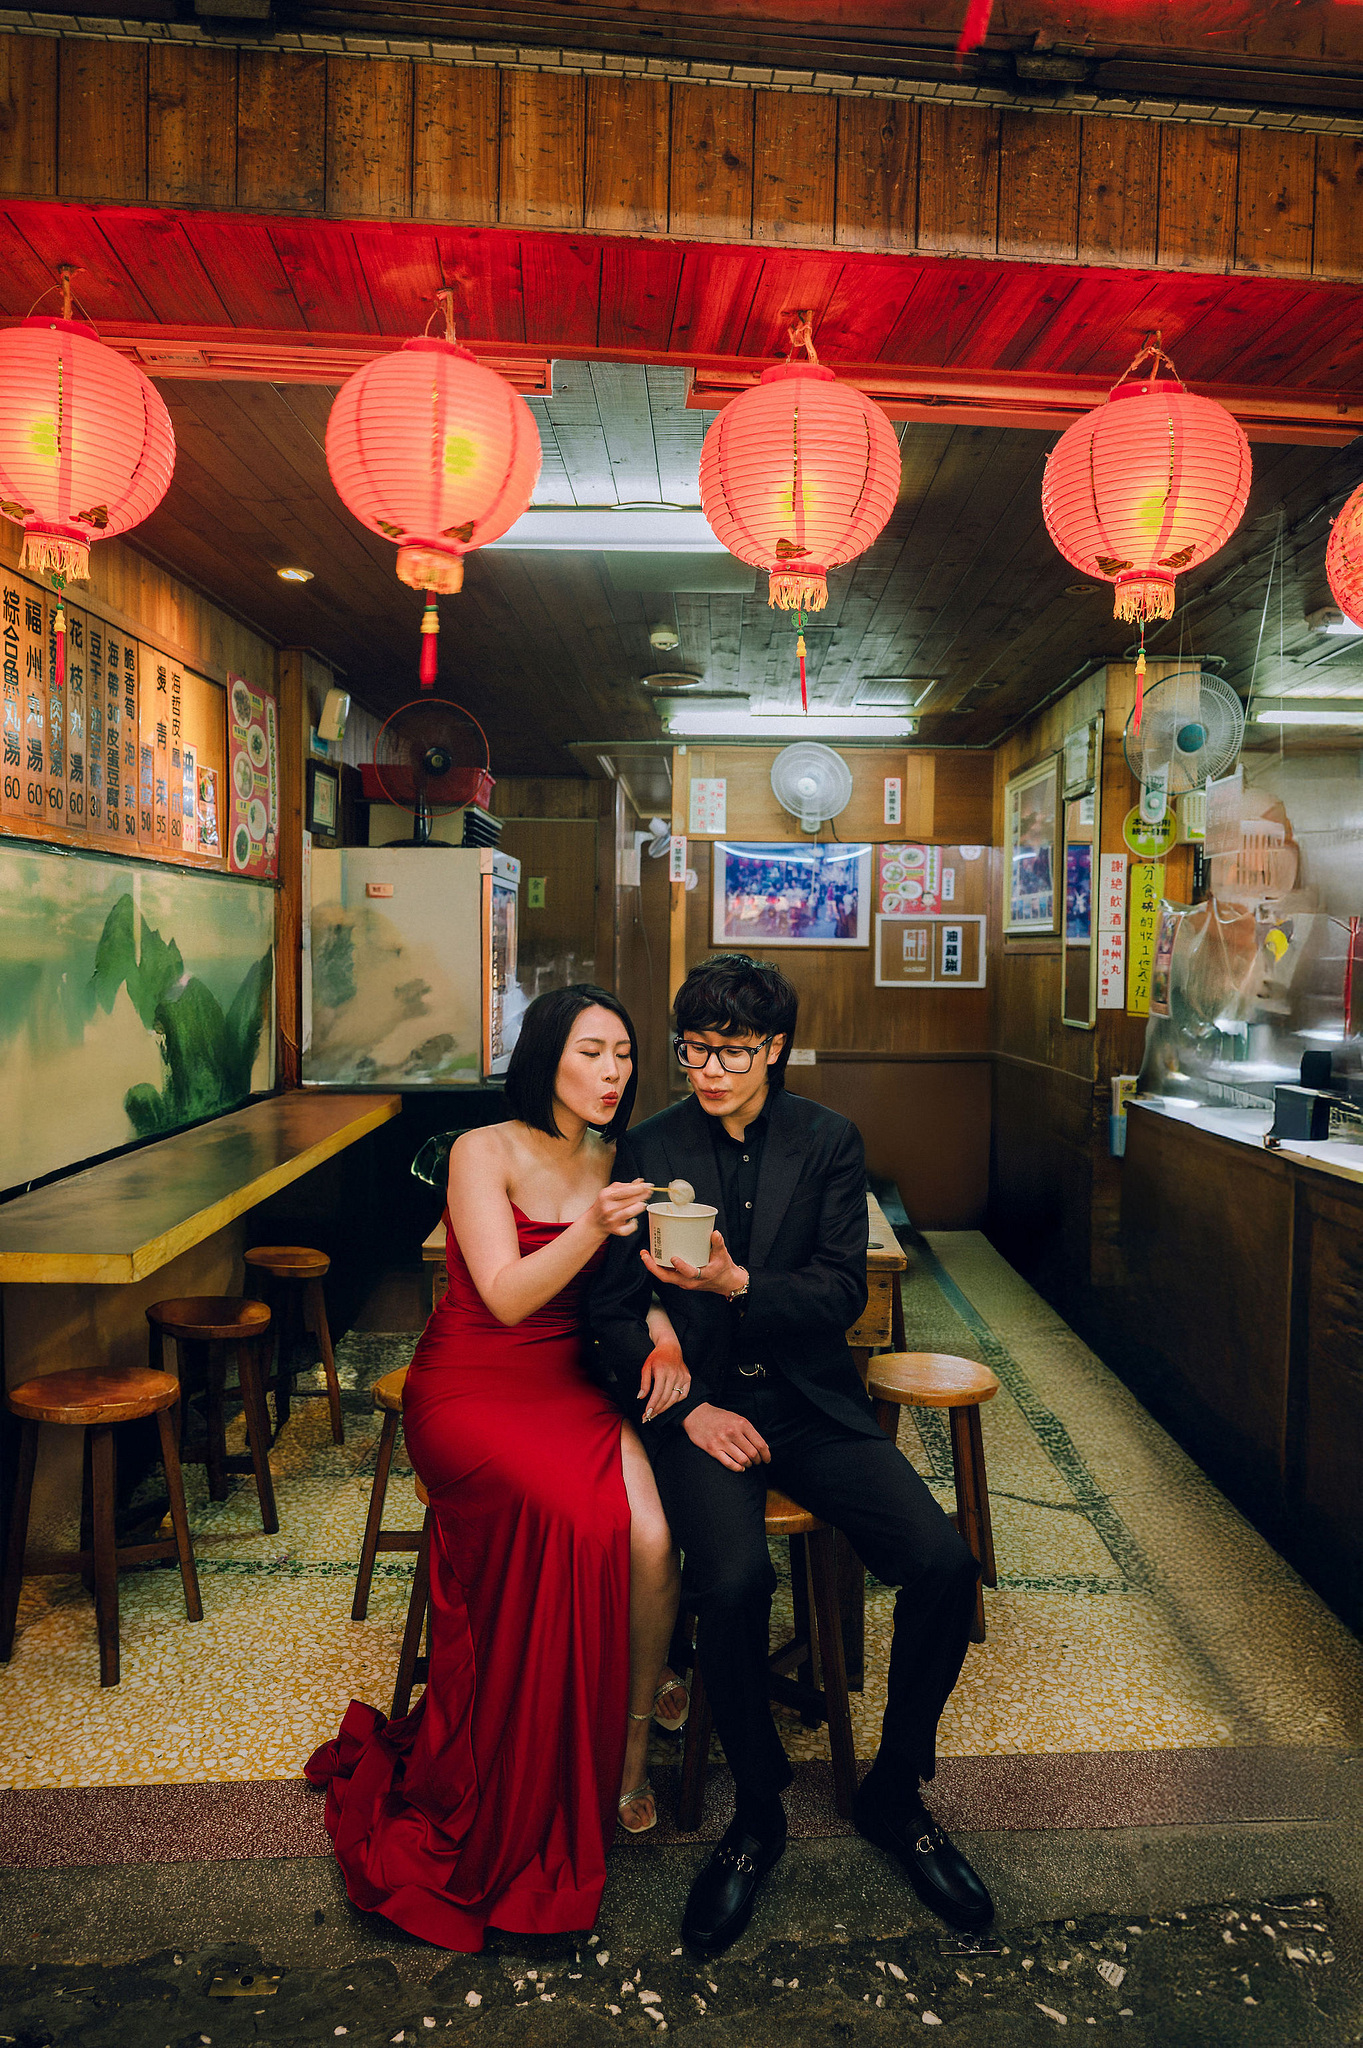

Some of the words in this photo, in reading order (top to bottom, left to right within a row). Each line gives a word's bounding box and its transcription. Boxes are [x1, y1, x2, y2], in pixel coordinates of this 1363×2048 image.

[3, 586, 20, 767] 綜合魚丸湯
[107, 702, 120, 724] 30
[106, 728, 120, 809] 皮蛋豆腐
[4, 775, 20, 800] 60
[27, 782, 42, 806] 60
[49, 787, 63, 810] 60
[69, 792, 83, 815] 60
[90, 795, 101, 818] 30
[107, 809, 120, 831] 50
[125, 815, 135, 836] 50
[141, 811, 151, 832] 50
[156, 814, 166, 834] 55
[171, 818, 181, 837] 80
[183, 823, 194, 843] 00
[1110, 859, 1124, 926] 謝絕飲酒
[1111, 935, 1123, 975] 福州丸
